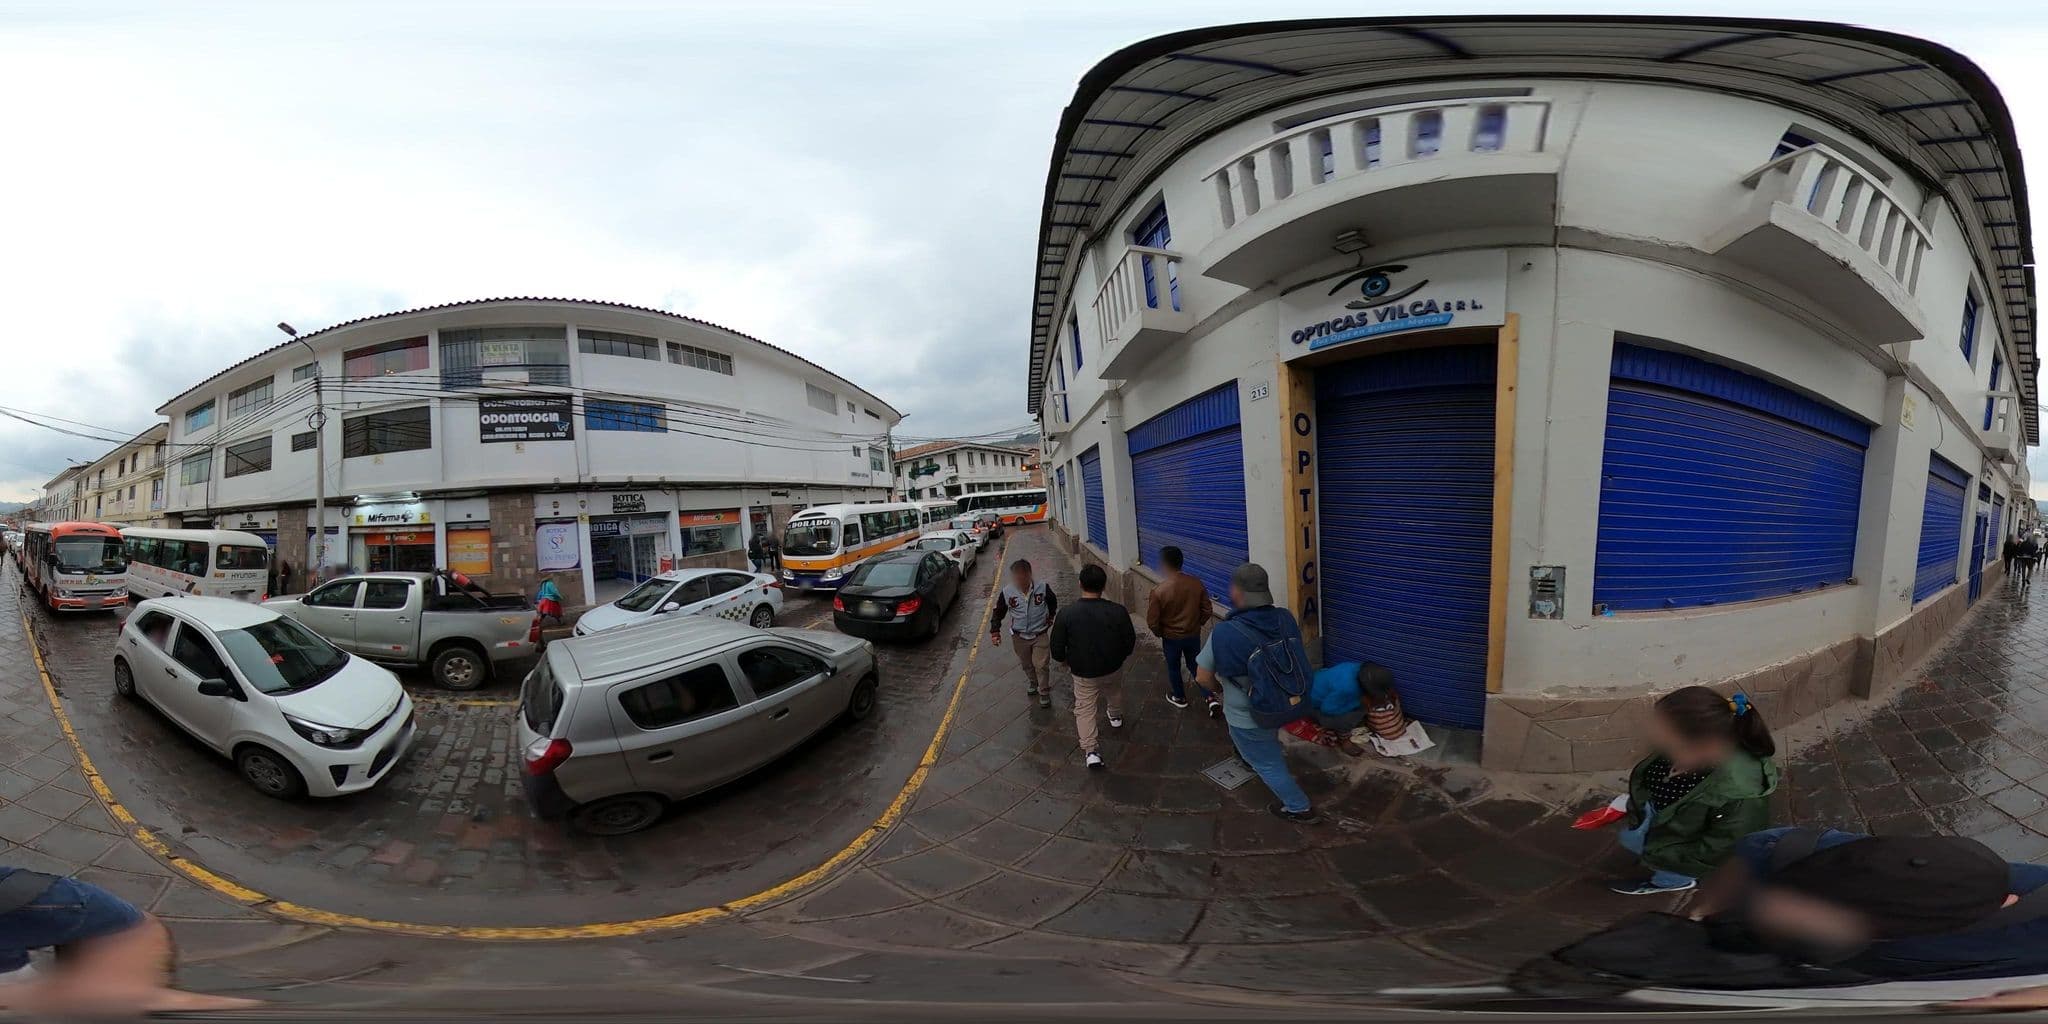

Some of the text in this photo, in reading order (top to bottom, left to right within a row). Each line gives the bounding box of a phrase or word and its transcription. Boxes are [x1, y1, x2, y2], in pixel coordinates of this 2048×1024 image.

[1291, 311, 1368, 345] OPTICAS
[1373, 298, 1440, 323] VILCA
[1353, 329, 1365, 337] en
[1251, 386, 1268, 400] 213
[481, 412, 560, 425] ODONTOLOGIA
[613, 494, 646, 504] BOTICA
[368, 513, 400, 523] Mifarma
[1294, 412, 1316, 619] OPTICA
[792, 519, 830, 528] DORADO
